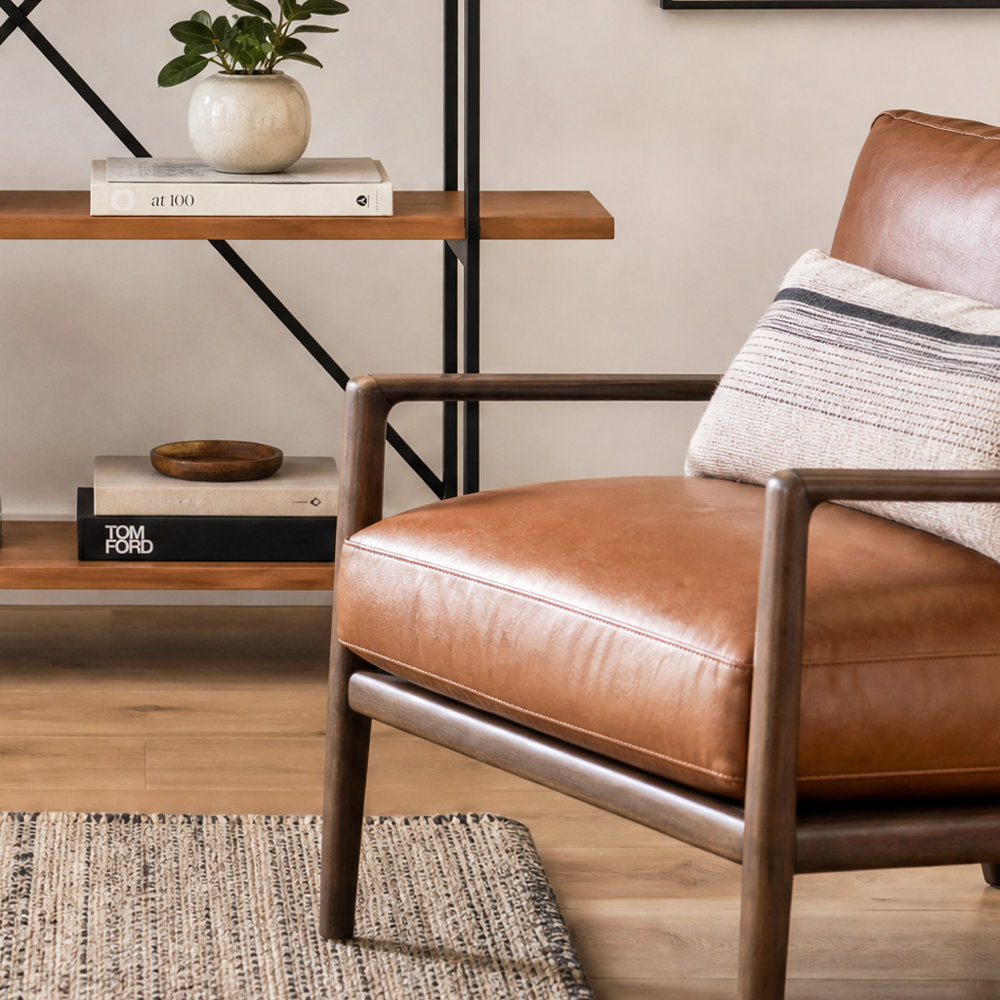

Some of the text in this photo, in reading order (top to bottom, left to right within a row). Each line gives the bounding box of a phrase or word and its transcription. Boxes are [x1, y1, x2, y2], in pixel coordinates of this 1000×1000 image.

[151, 194, 195, 207] at 100
[105, 525, 146, 540] TOM
[105, 539, 154, 554] FORD
